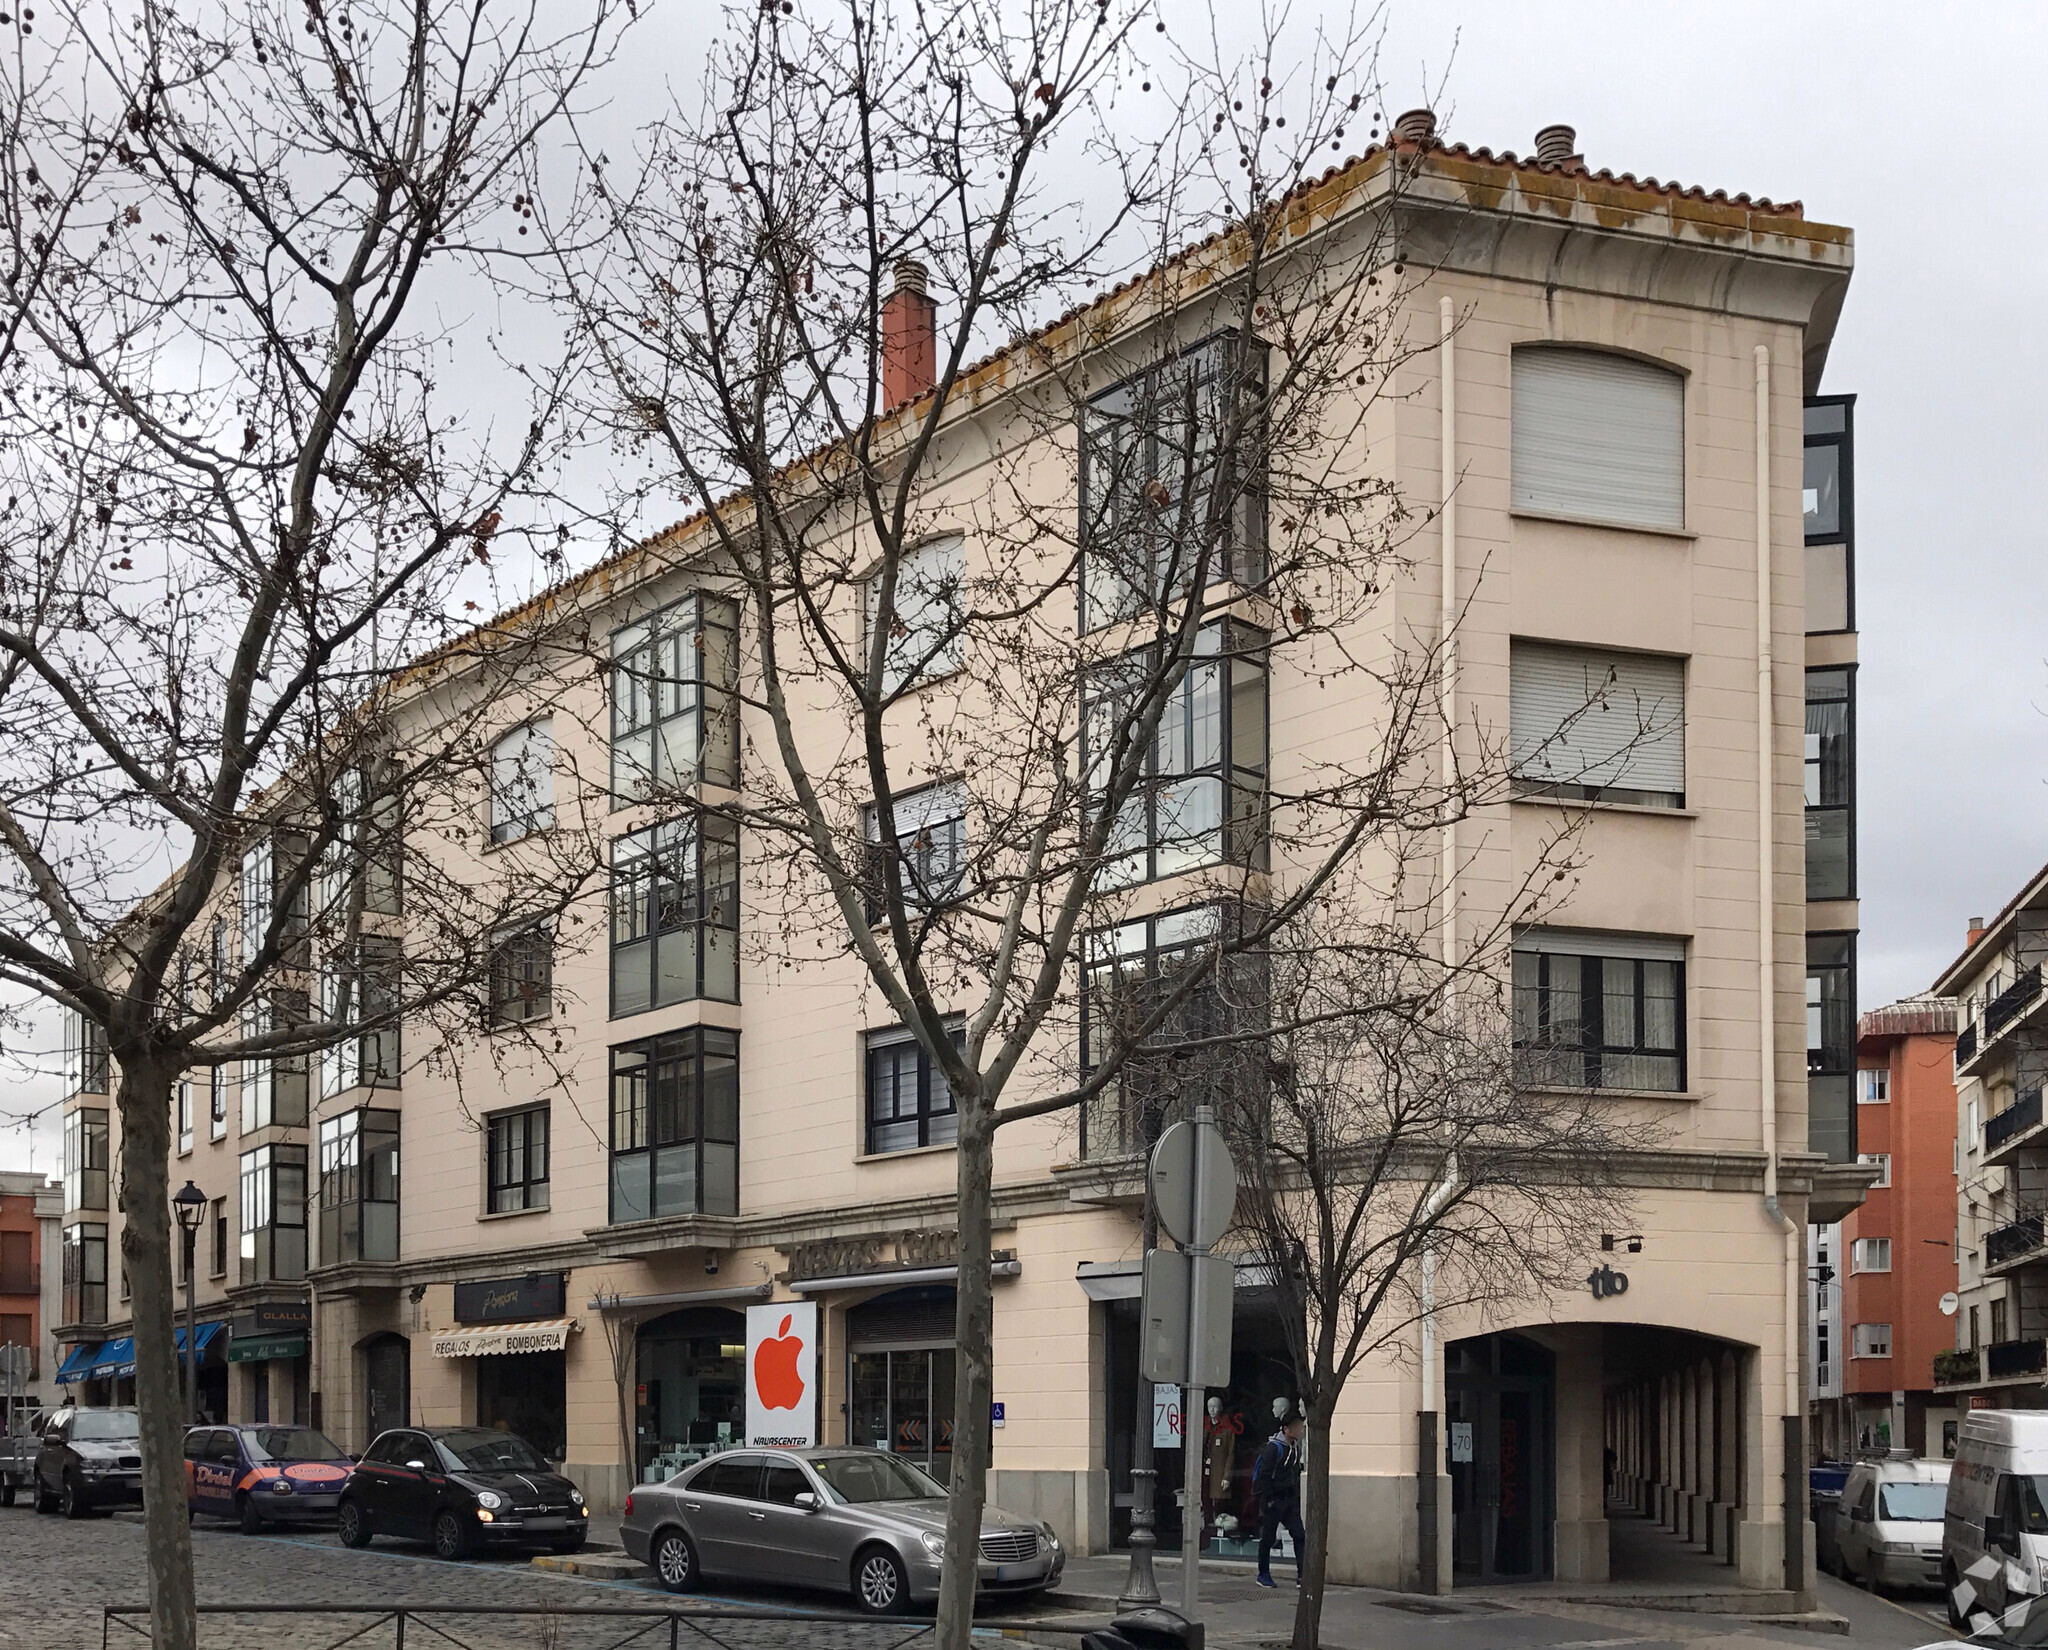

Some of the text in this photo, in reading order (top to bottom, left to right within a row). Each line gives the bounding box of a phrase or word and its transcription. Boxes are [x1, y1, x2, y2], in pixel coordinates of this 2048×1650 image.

[262, 1312, 307, 1320] OLALLA
[434, 1340, 471, 1355] REGALOS
[506, 1333, 561, 1350] BOMBONERIA
[1169, 1412, 1245, 1435] REAJAS
[1453, 1435, 1472, 1451] -70
